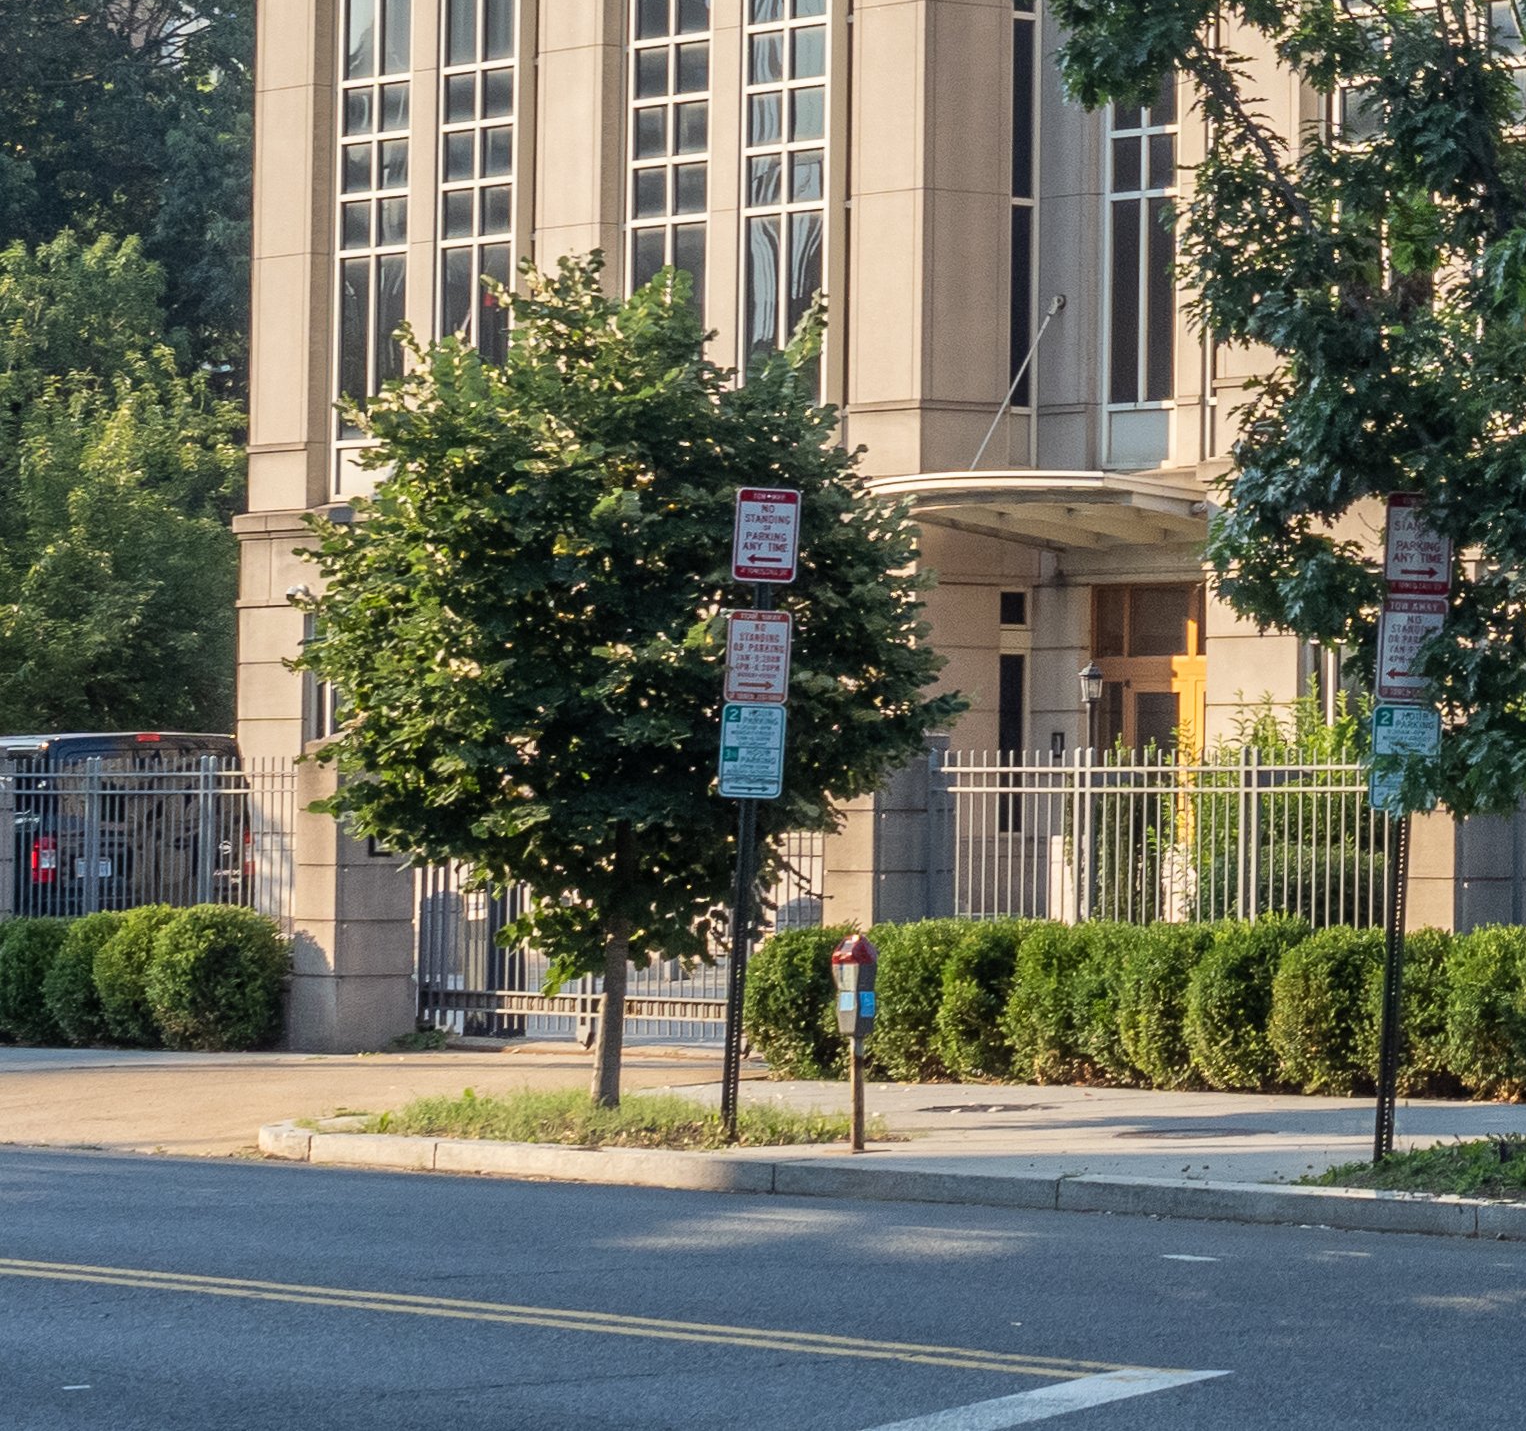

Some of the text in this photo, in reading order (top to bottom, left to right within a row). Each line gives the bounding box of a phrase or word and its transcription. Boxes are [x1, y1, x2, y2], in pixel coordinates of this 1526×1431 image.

[761, 504, 775, 513] NO
[744, 514, 791, 525] STANDING
[745, 531, 787, 542] PARKING
[743, 542, 788, 552] ANY TIME
[1395, 540, 1440, 552] PARKING
[1392, 553, 1443, 563] ANY TIME
[1407, 615, 1422, 624] NO
[729, 709, 739, 721] 2
[1380, 711, 1391, 724] 2
